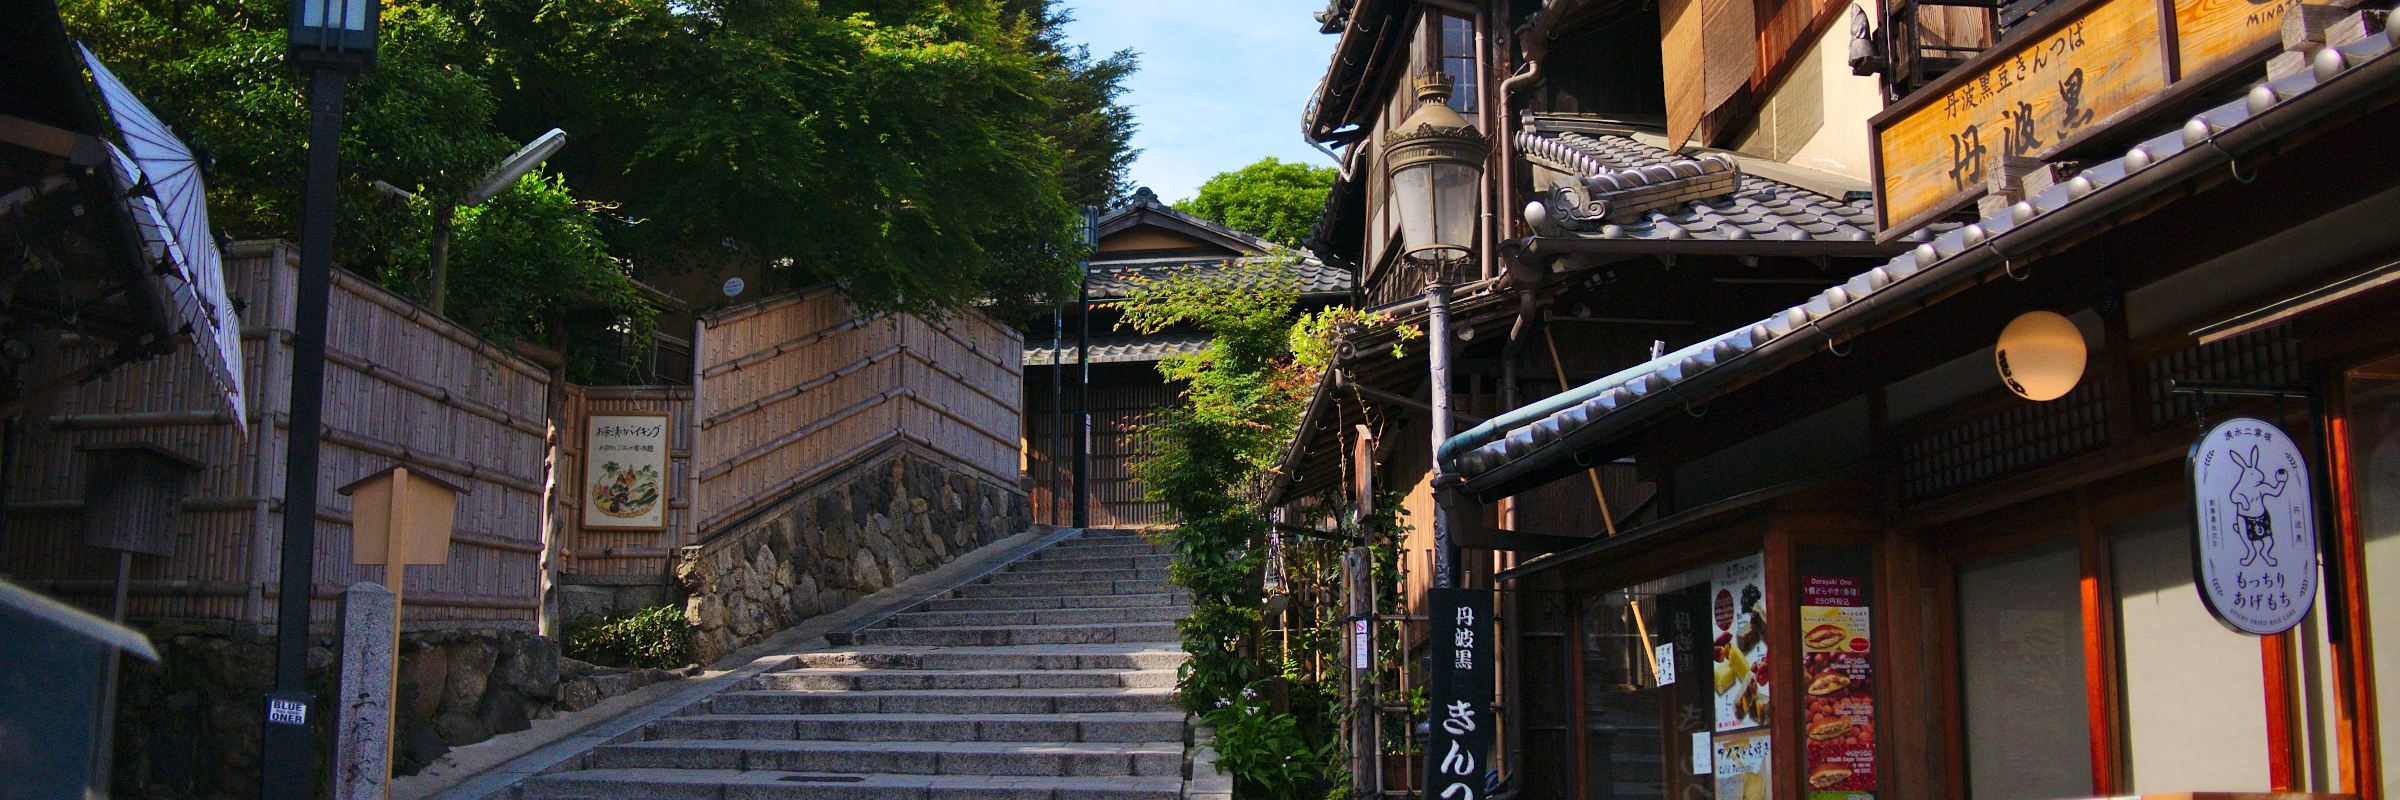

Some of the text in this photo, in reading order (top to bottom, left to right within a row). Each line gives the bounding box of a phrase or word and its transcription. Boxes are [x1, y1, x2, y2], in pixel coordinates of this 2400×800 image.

[1944, 18, 2085, 120] 丹波黒豆きんつば
[1949, 67, 2094, 192] 丹波黒
[2234, 591, 2291, 611] あげもち
[2236, 571, 2285, 589] もっちり
[1455, 606, 1474, 670] 丹波黒
[273, 701, 303, 711] BLUE
